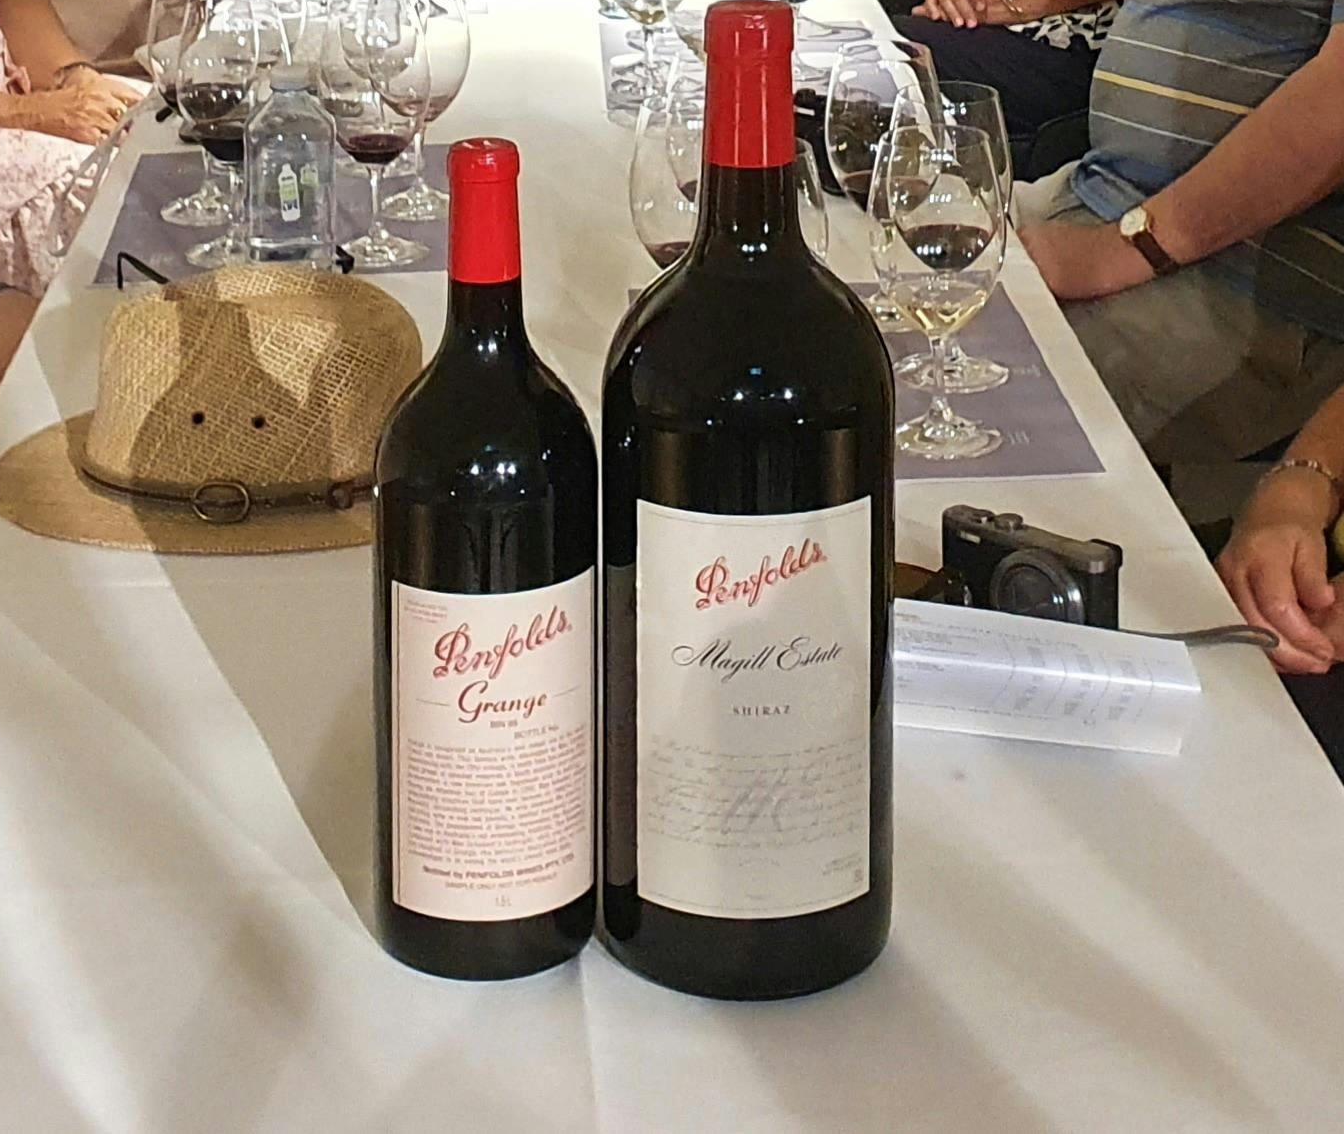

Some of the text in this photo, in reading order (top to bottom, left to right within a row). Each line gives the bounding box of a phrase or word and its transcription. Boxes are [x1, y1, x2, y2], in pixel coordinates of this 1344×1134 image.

[695, 537, 824, 610] Penfolds
[432, 604, 568, 679] Penfolds
[671, 636, 844, 684] Magill Estate
[458, 680, 548, 724] Grange
[732, 704, 791, 717] SHIRAZ
